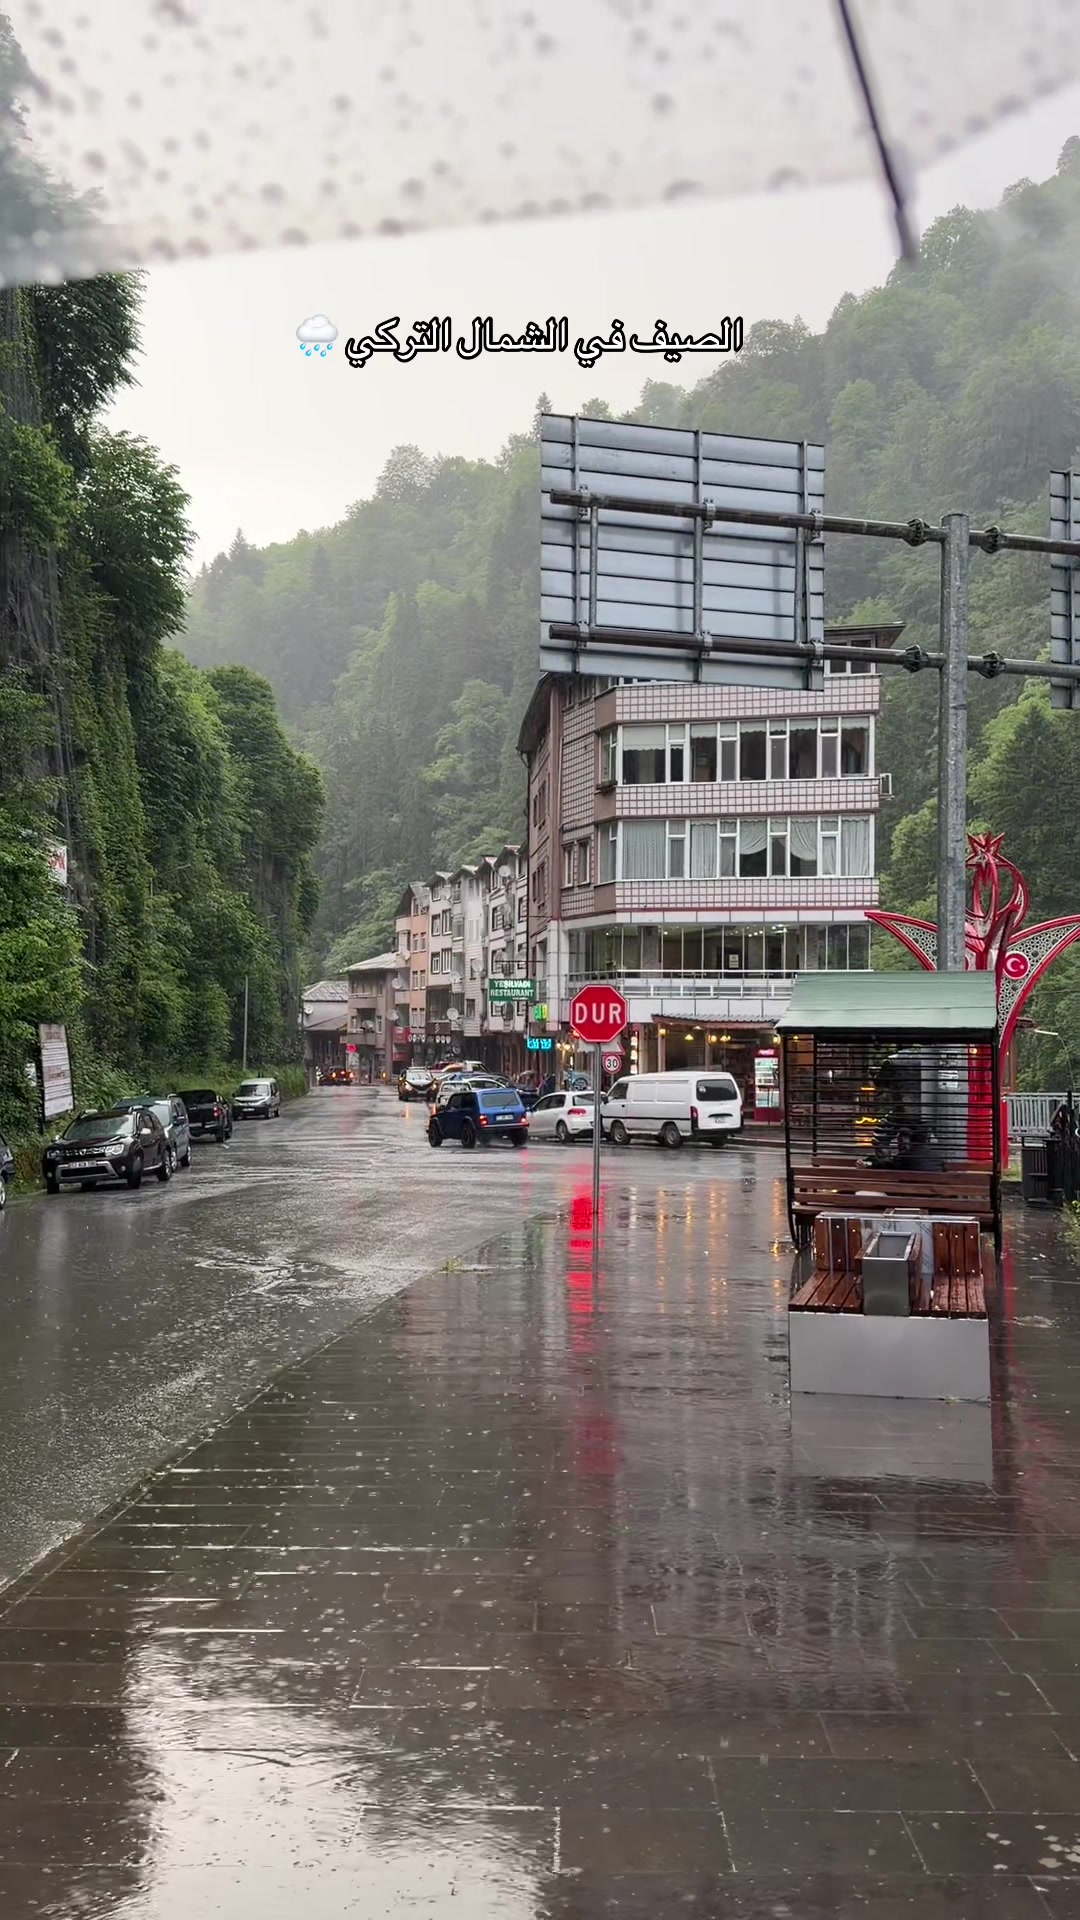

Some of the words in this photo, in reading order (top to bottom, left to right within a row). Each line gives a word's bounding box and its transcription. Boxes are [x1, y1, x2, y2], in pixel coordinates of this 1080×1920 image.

[490, 989, 534, 997] RESTAURANT
[575, 1003, 622, 1024] DUR
[606, 1058, 618, 1068] 30
